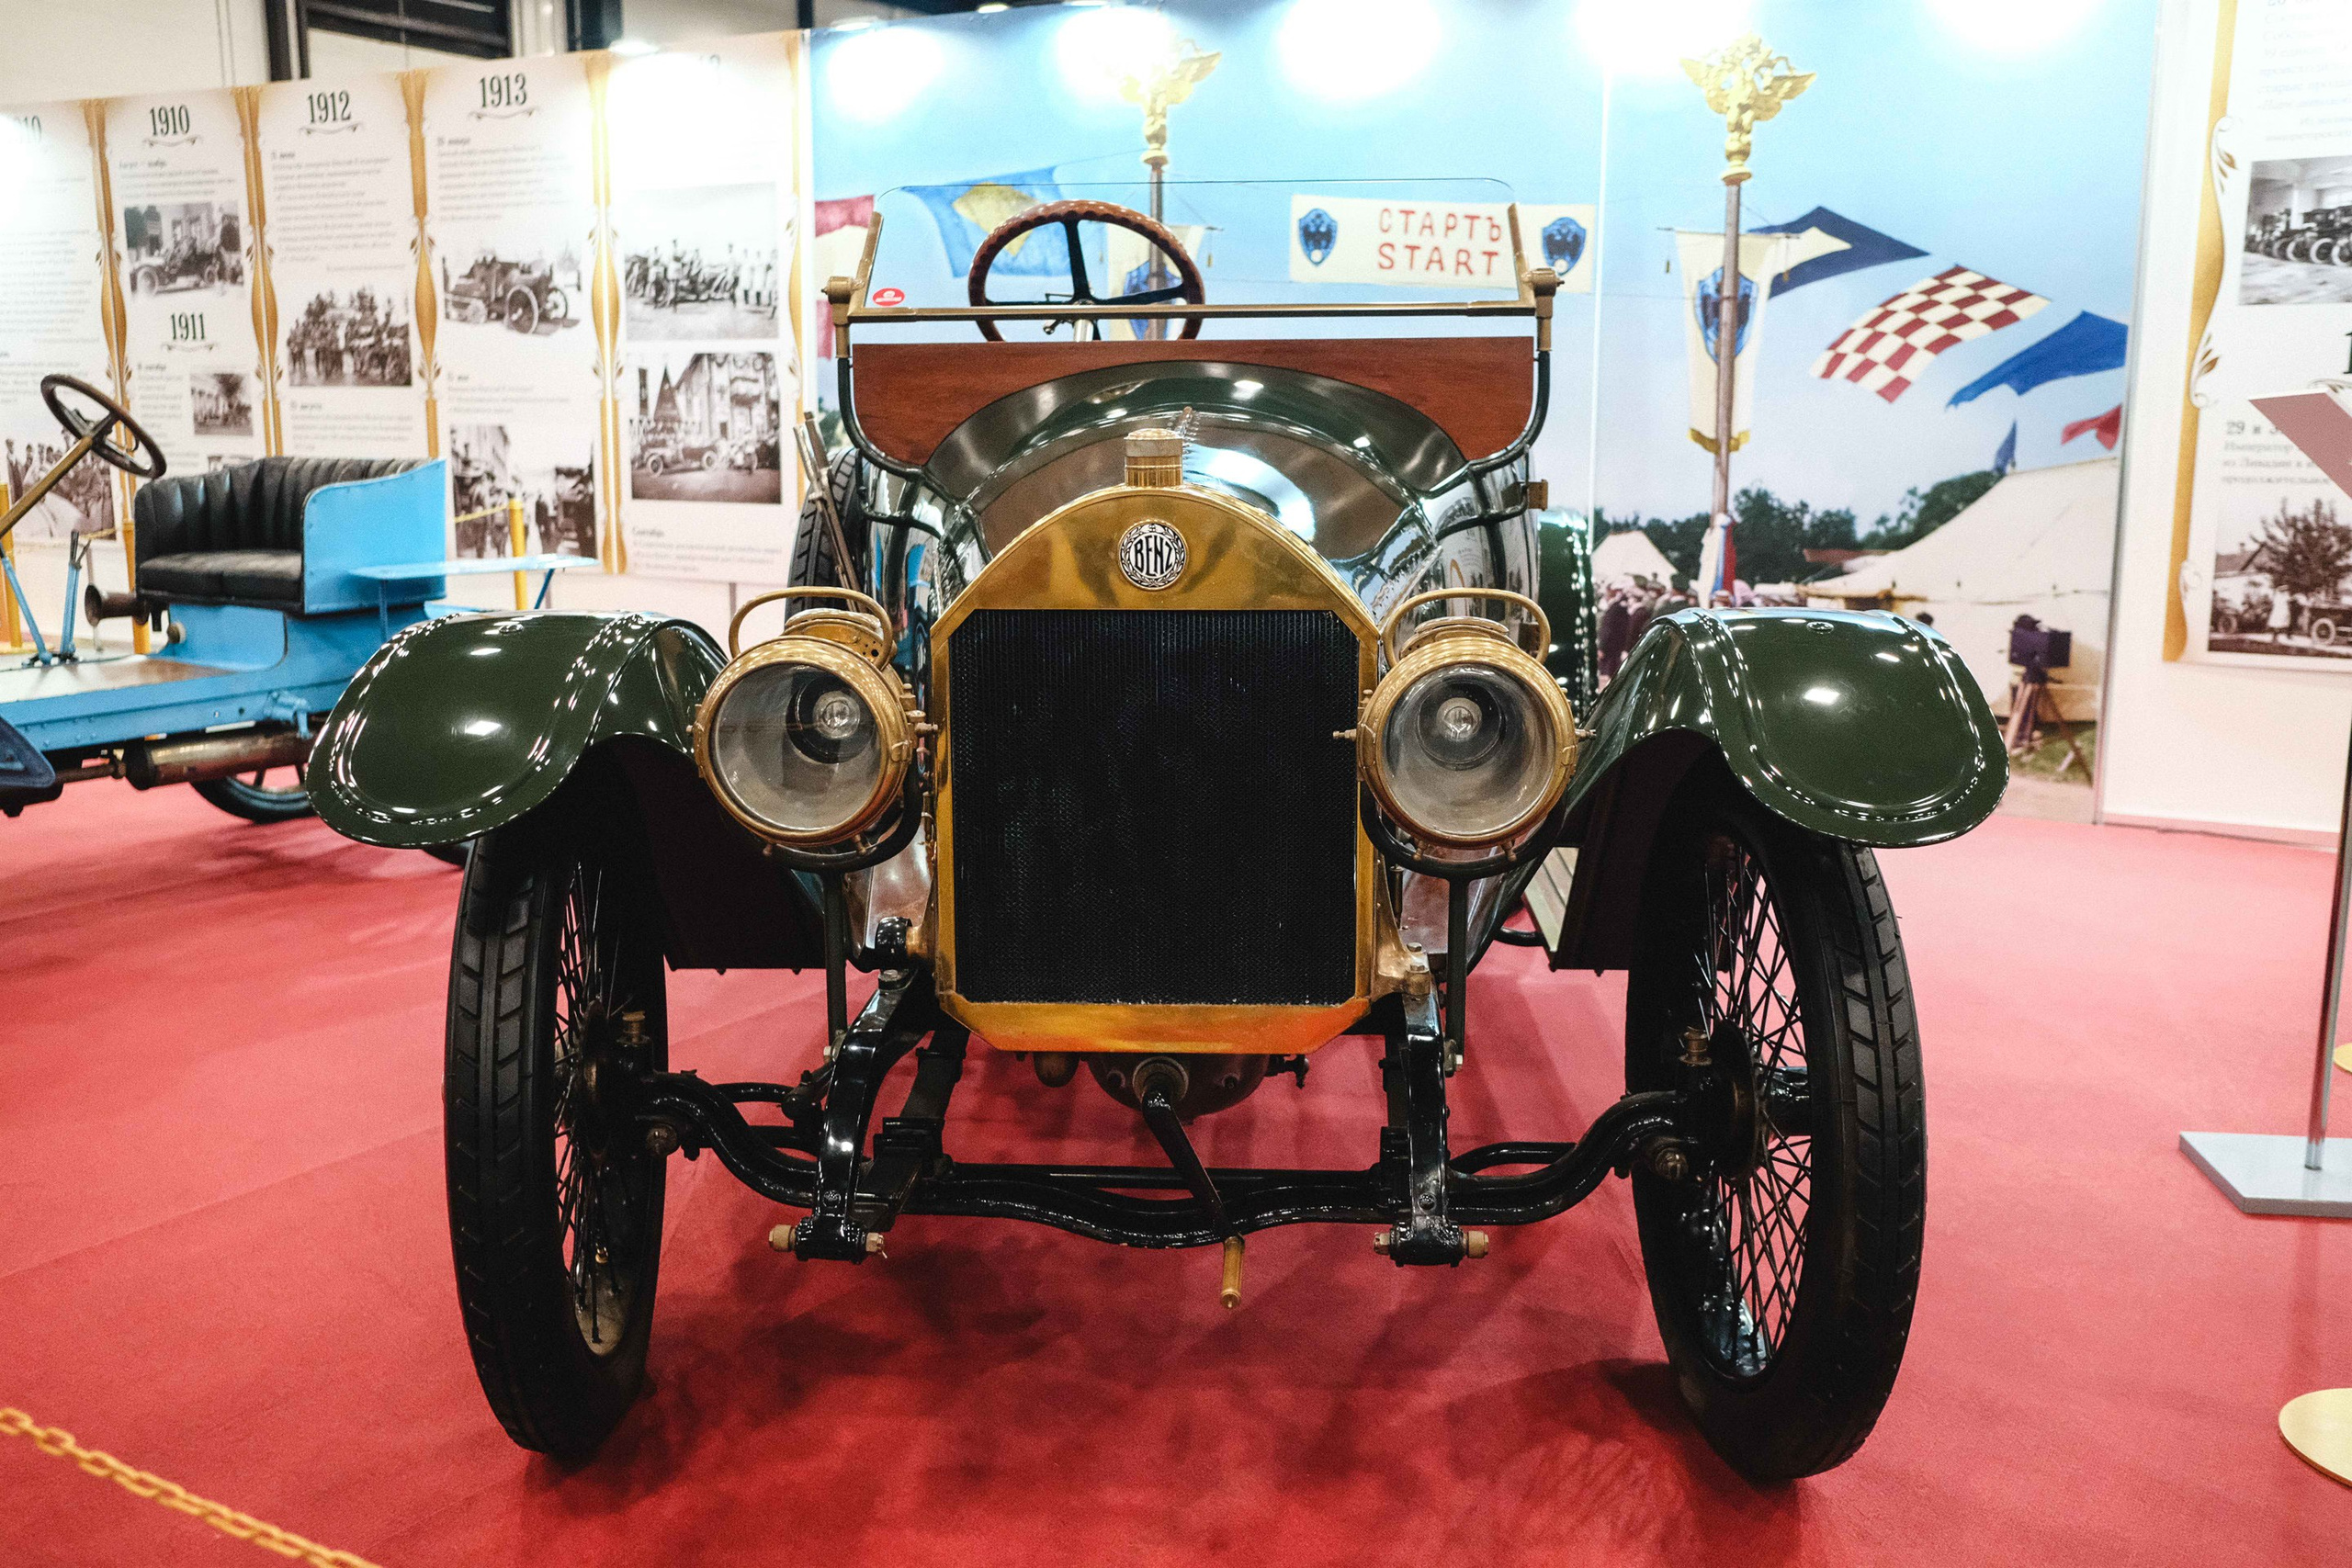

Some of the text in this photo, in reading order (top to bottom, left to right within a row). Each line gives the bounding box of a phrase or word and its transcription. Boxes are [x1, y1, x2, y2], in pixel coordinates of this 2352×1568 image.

[307, 90, 352, 124] 1912
[480, 73, 528, 108] 1913
[150, 105, 190, 136] 1910
[1379, 208, 1502, 243] СТАРТЪ
[1378, 243, 1499, 276] START
[171, 312, 206, 341] 1911
[1134, 535, 1173, 577] BENZ
